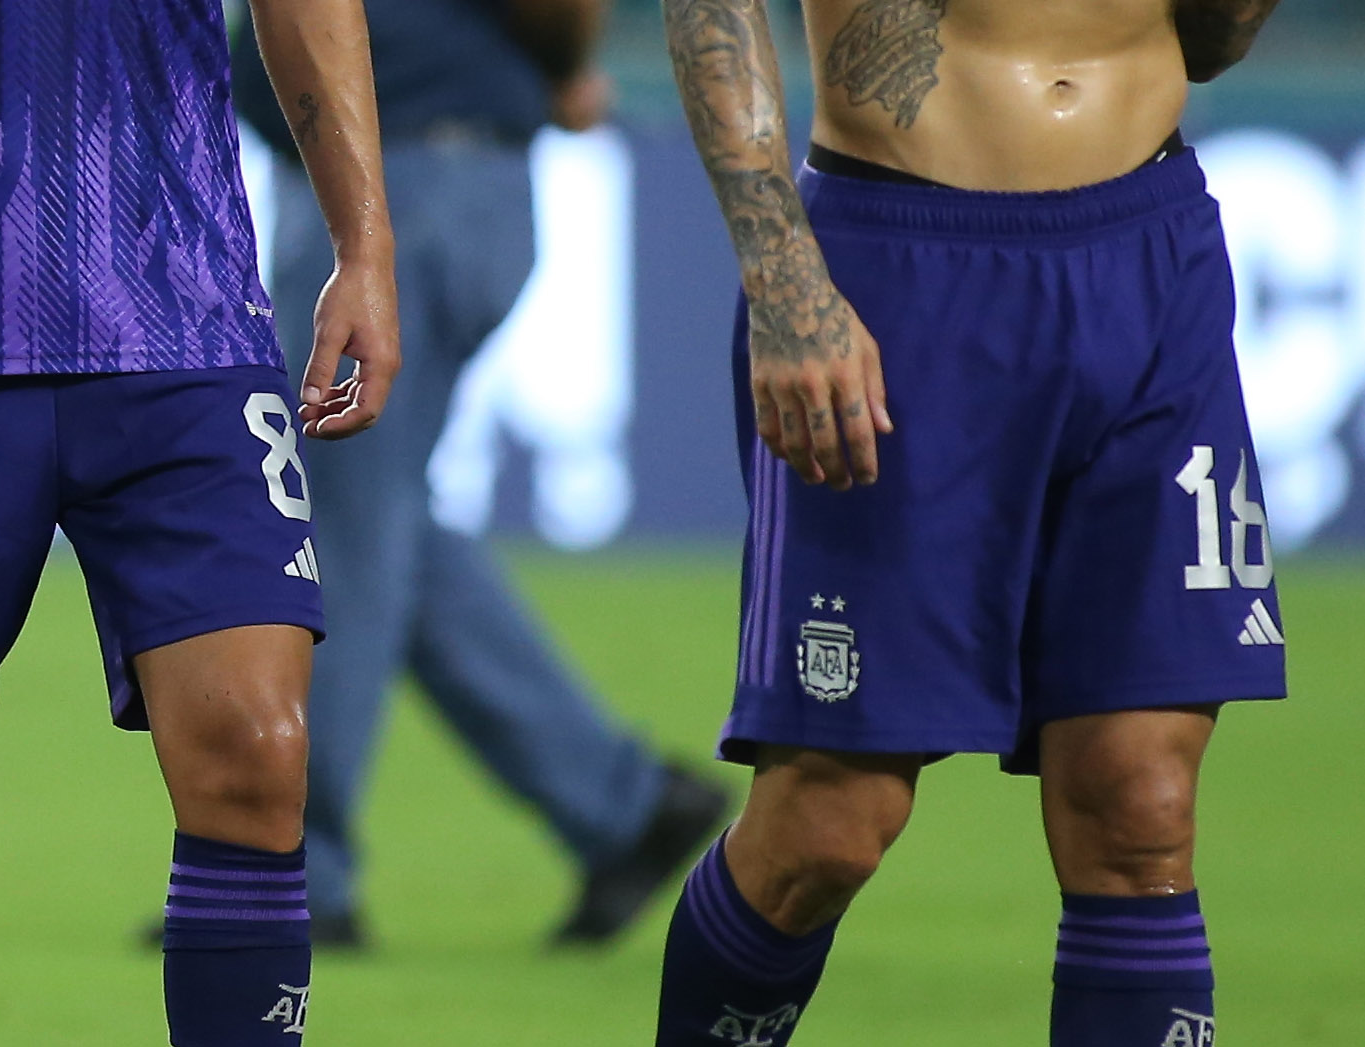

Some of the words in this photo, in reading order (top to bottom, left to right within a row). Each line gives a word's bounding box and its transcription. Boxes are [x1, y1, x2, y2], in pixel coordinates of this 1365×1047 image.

[243, 393, 312, 522] 8
[1175, 446, 1274, 589] 16
[811, 644, 843, 680] AFA
[261, 983, 309, 1034] AF
[1160, 1008, 1215, 1047] AF
